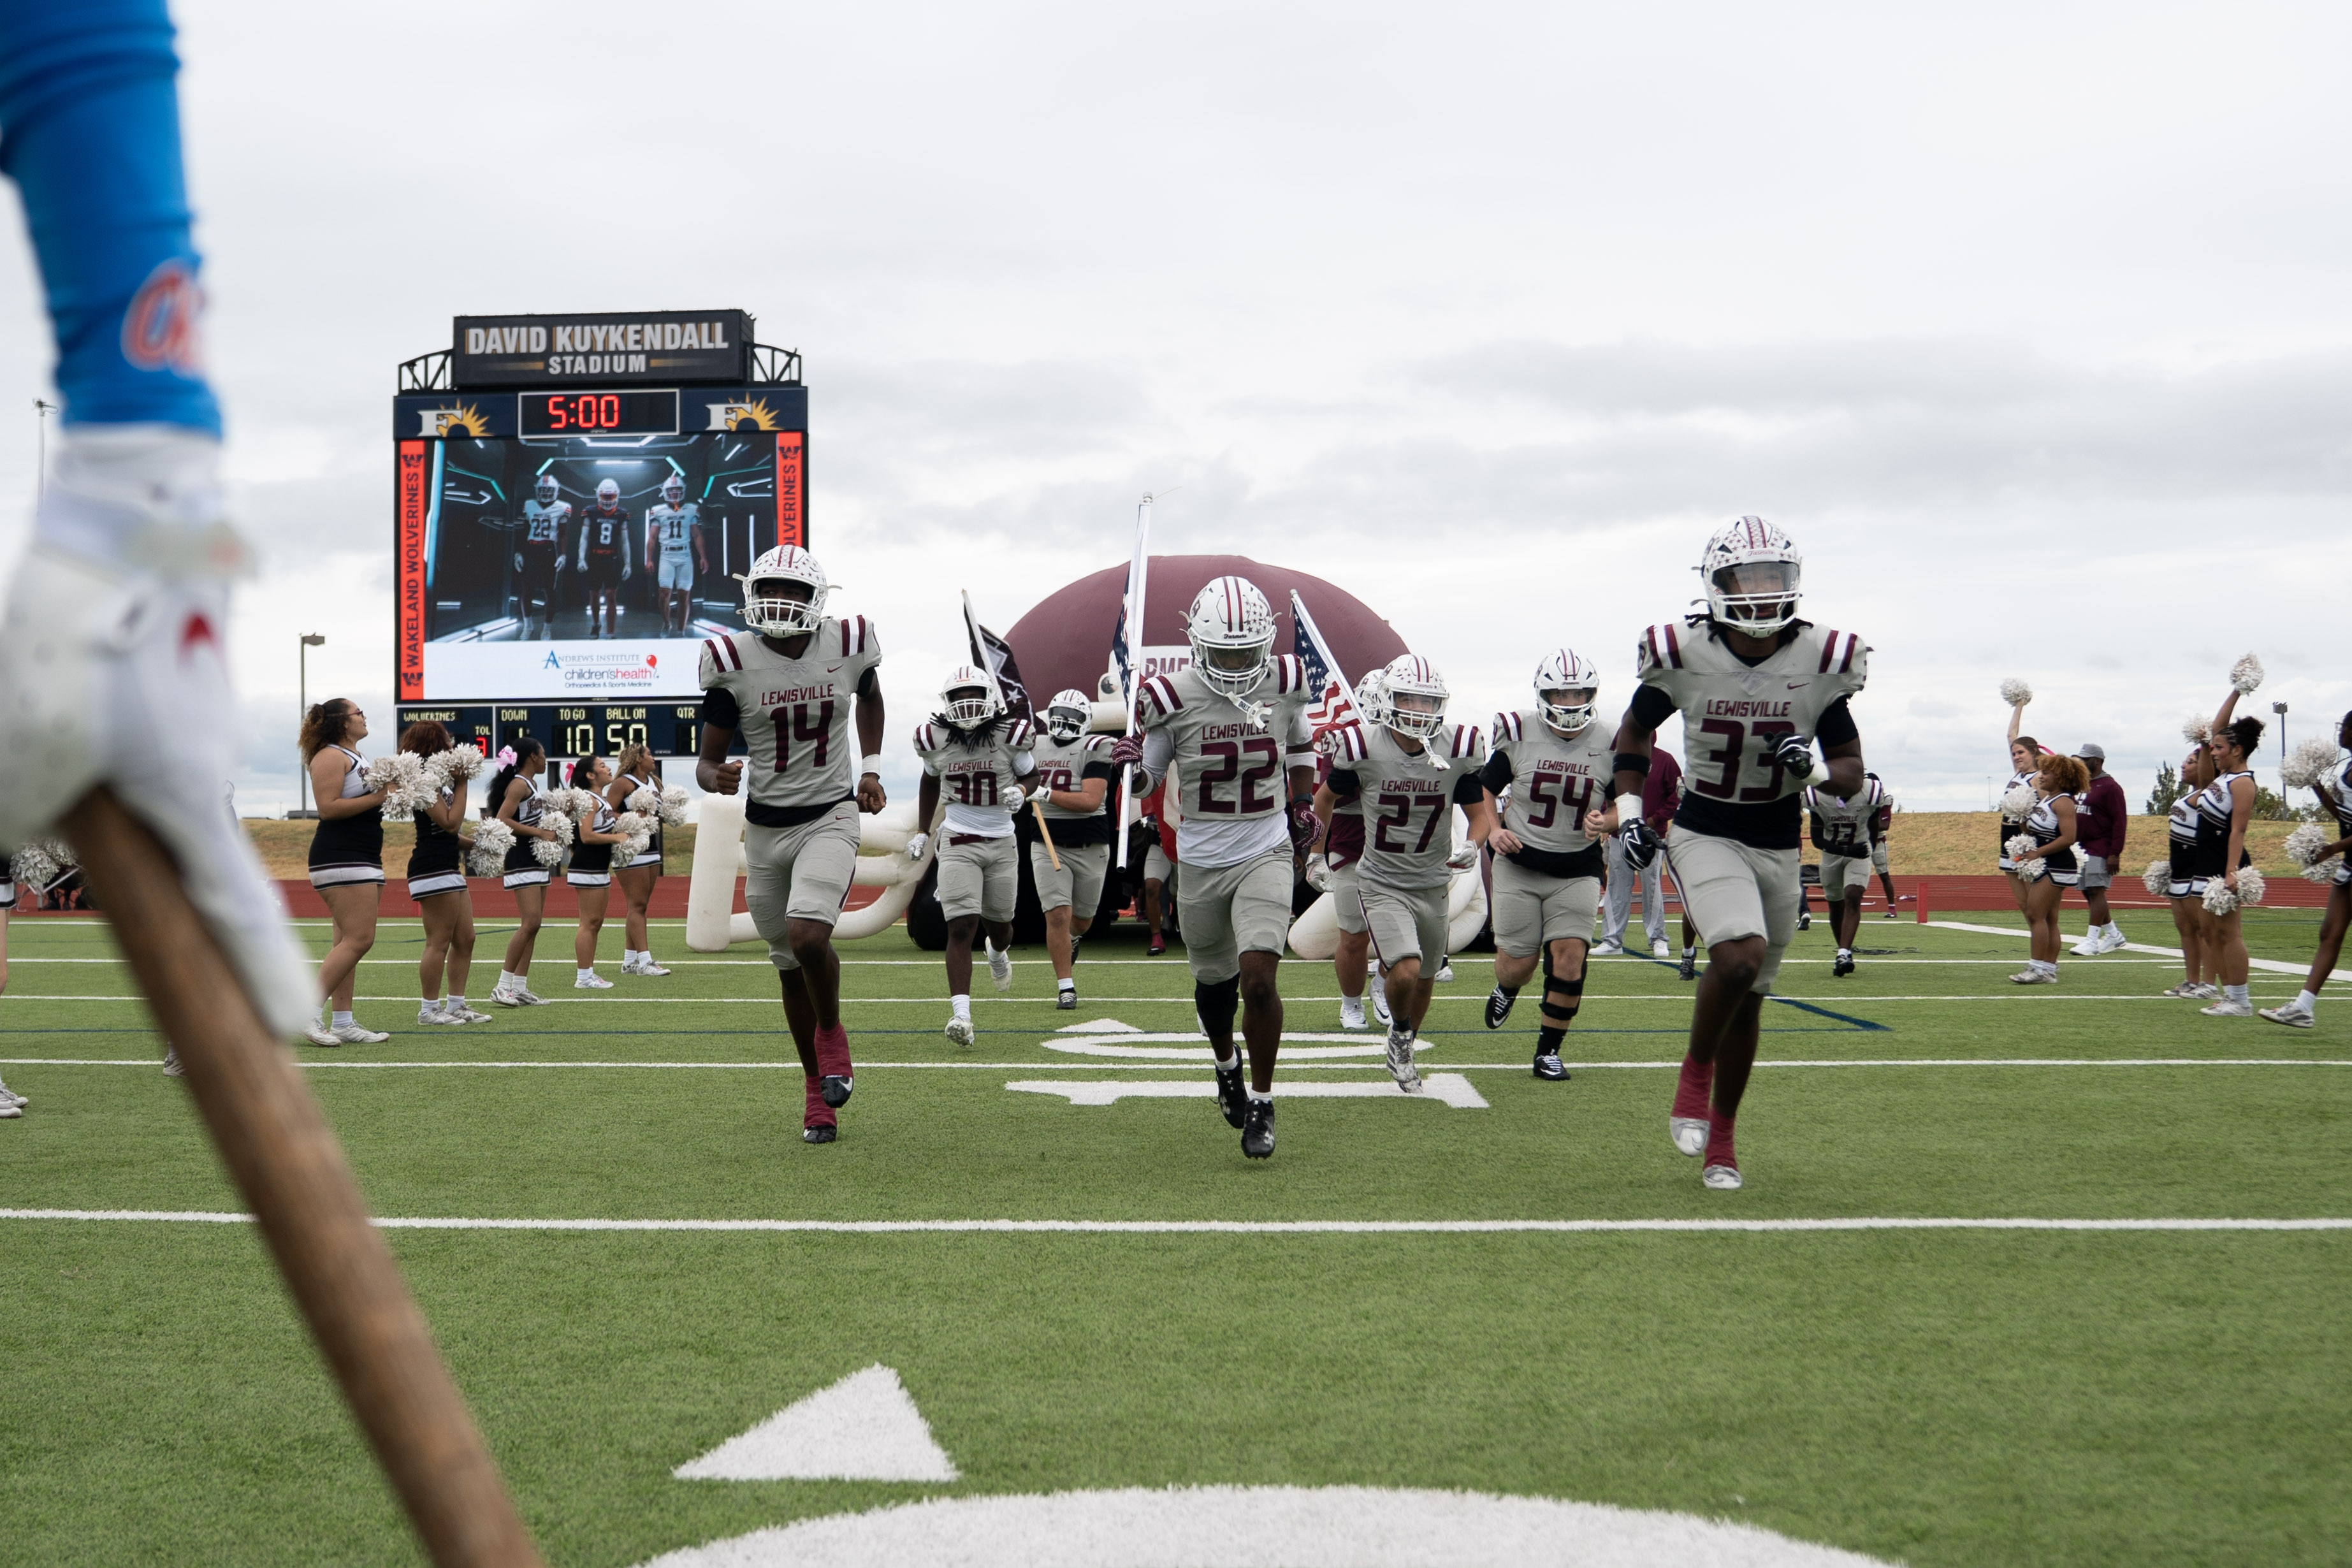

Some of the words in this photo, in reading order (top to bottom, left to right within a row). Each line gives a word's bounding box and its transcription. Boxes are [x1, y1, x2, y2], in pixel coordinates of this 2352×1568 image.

[465, 326, 547, 354] DAVID
[553, 322, 729, 353] KUYKENDALL
[549, 354, 646, 375] STADIUM
[548, 395, 619, 428] 5:00
[405, 472, 419, 573] WOLVERINES
[532, 519, 551, 538] 22
[669, 521, 681, 539] 11
[600, 523, 613, 544] 8
[406, 578, 419, 669] WAKELAND
[761, 683, 834, 706] LEWISVILLE
[403, 711, 455, 722] WOLVERINES
[501, 709, 528, 722] DOWN
[560, 709, 570, 720] TO
[573, 708, 586, 720] GO
[606, 708, 631, 720] BALL
[633, 707, 646, 720] ON
[677, 707, 695, 719] QTR
[1706, 699, 1792, 717] LEWISVILLE
[475, 725, 491, 736] TOL
[567, 724, 594, 756] 10
[607, 723, 647, 756] 50
[691, 725, 696, 753] 1
[770, 700, 834, 773] 14
[1202, 720, 1270, 741] LEWISVILLE
[948, 760, 994, 773] LEWISVILLE
[1038, 760, 1071, 768] LEWISVILLE
[1537, 759, 1590, 776] LEWISVILLE
[1694, 718, 1795, 802] 33
[1198, 737, 1279, 814] 22
[1381, 780, 1441, 792] LEWISVILLE
[945, 771, 998, 806] 30
[1527, 771, 1595, 831] 54
[1374, 794, 1446, 853] 27
